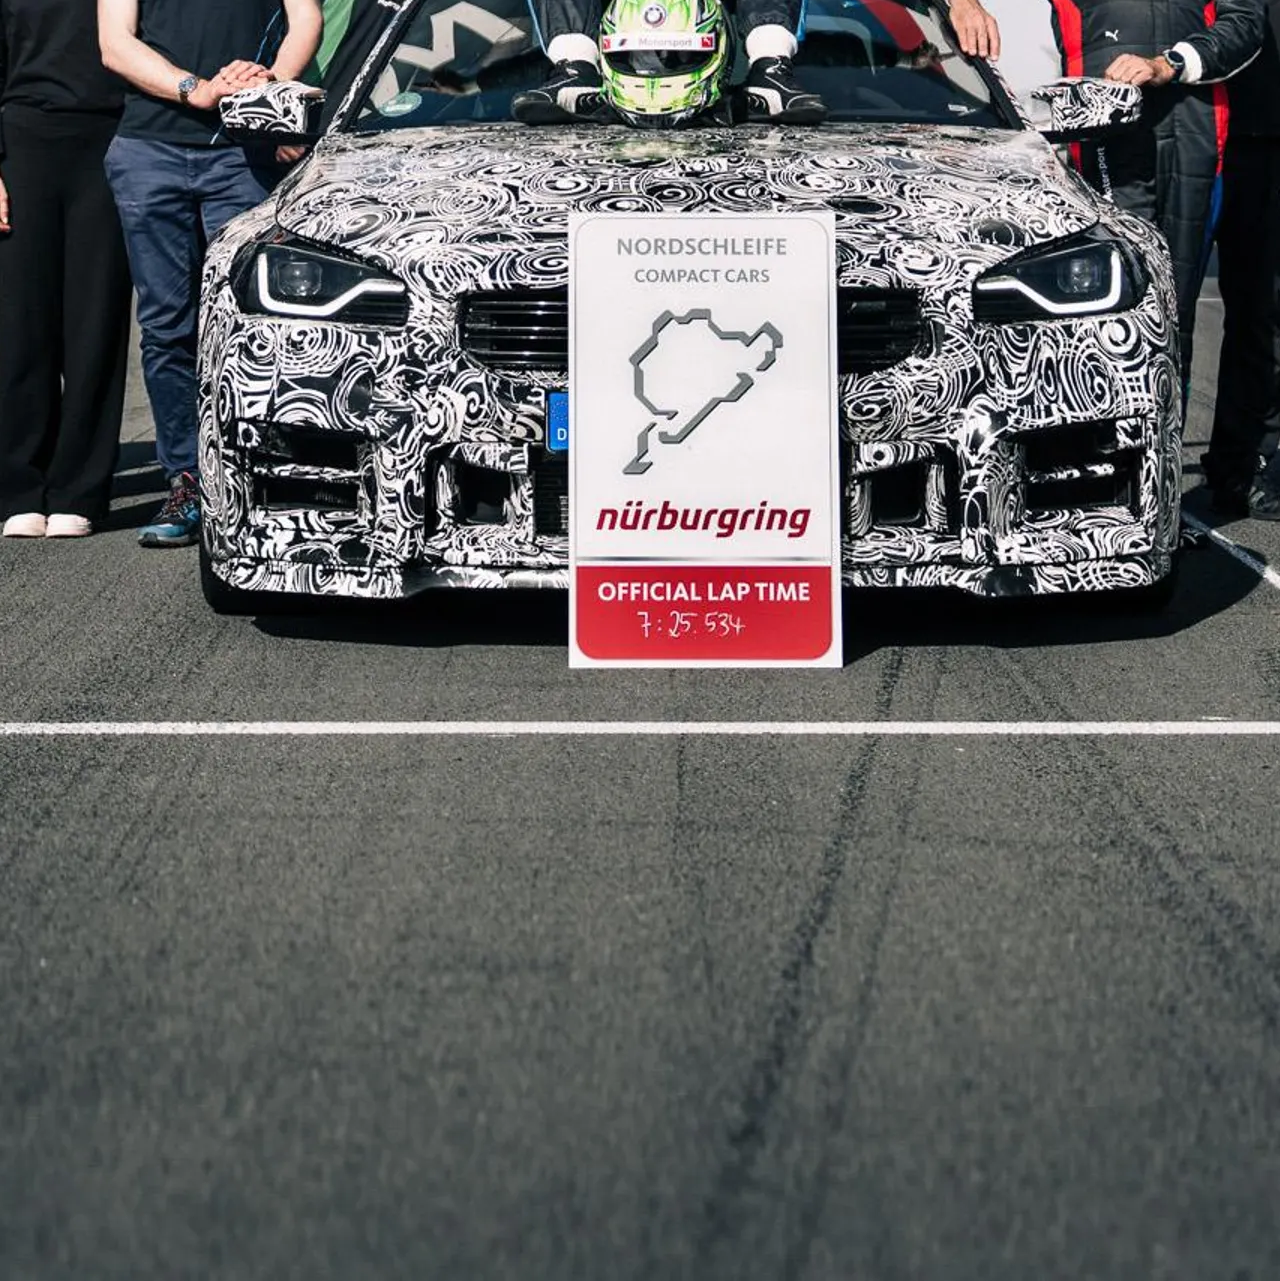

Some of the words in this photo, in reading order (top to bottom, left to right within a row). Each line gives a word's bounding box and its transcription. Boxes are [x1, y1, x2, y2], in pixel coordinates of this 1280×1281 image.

[617, 237, 787, 256] NORDSCHLEIFE
[634, 269, 720, 284] COMPACT
[725, 269, 770, 284] CARS
[557, 428, 568, 440] D
[596, 500, 812, 538] nürburgring
[598, 582, 702, 601] OFFICIAL
[707, 582, 750, 601] LAP
[755, 582, 810, 601] TIME
